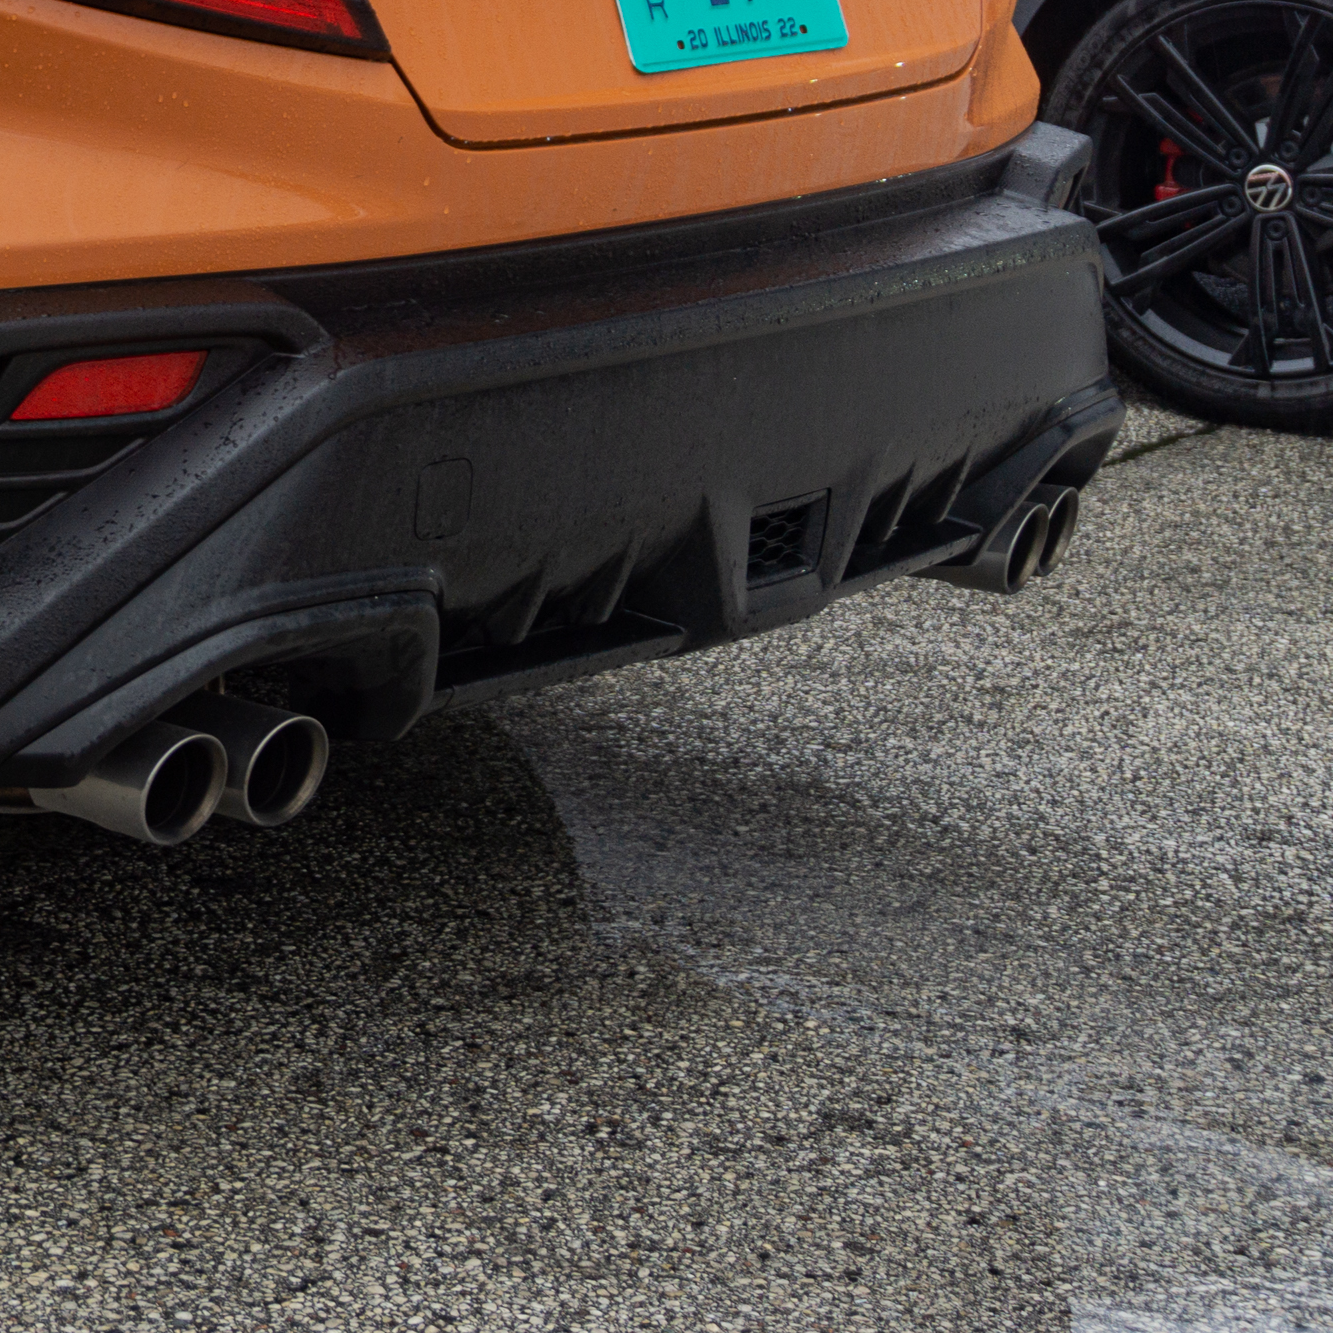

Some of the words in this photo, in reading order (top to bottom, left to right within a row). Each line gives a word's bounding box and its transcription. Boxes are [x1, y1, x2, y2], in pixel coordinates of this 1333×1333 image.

[687, 28, 709, 50] 20
[713, 19, 772, 48] ILLINOIS
[776, 16, 799, 39] 22
